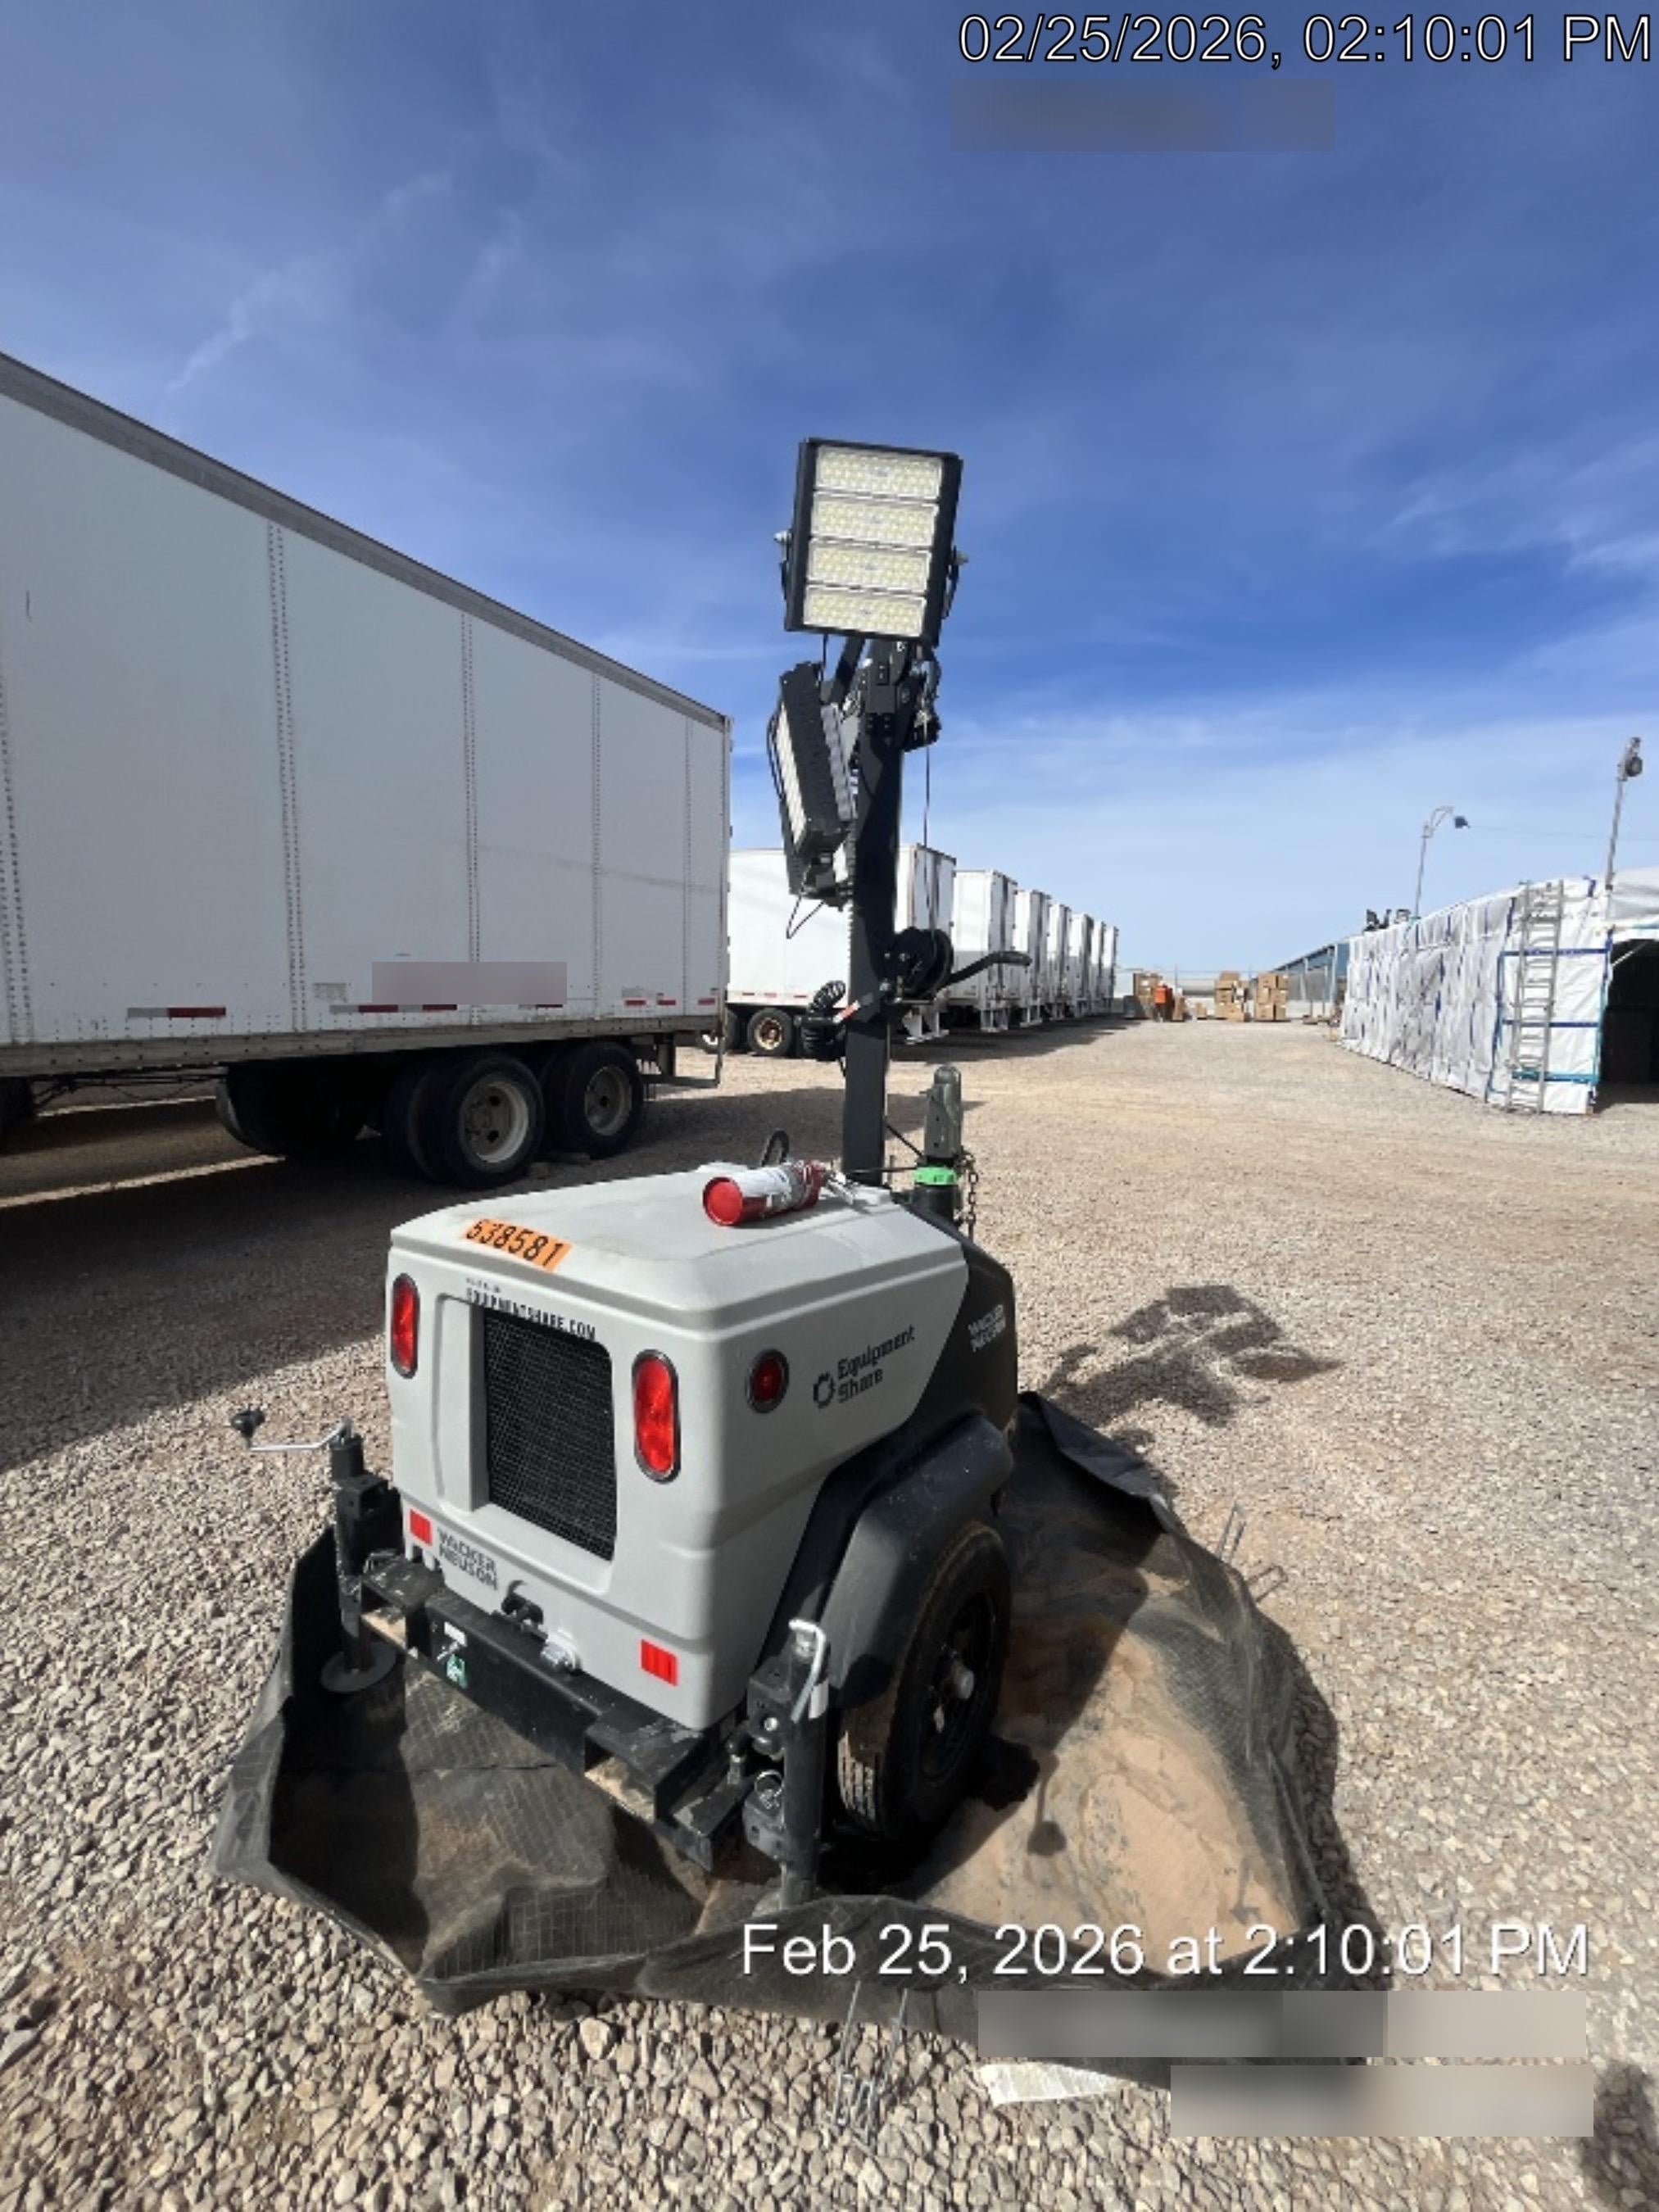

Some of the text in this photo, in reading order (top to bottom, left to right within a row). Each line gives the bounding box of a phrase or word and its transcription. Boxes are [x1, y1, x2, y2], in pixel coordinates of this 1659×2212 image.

[465, 1218, 564, 1267] 538581
[836, 1324, 916, 1380] Equipment
[837, 1368, 883, 1403] Share
